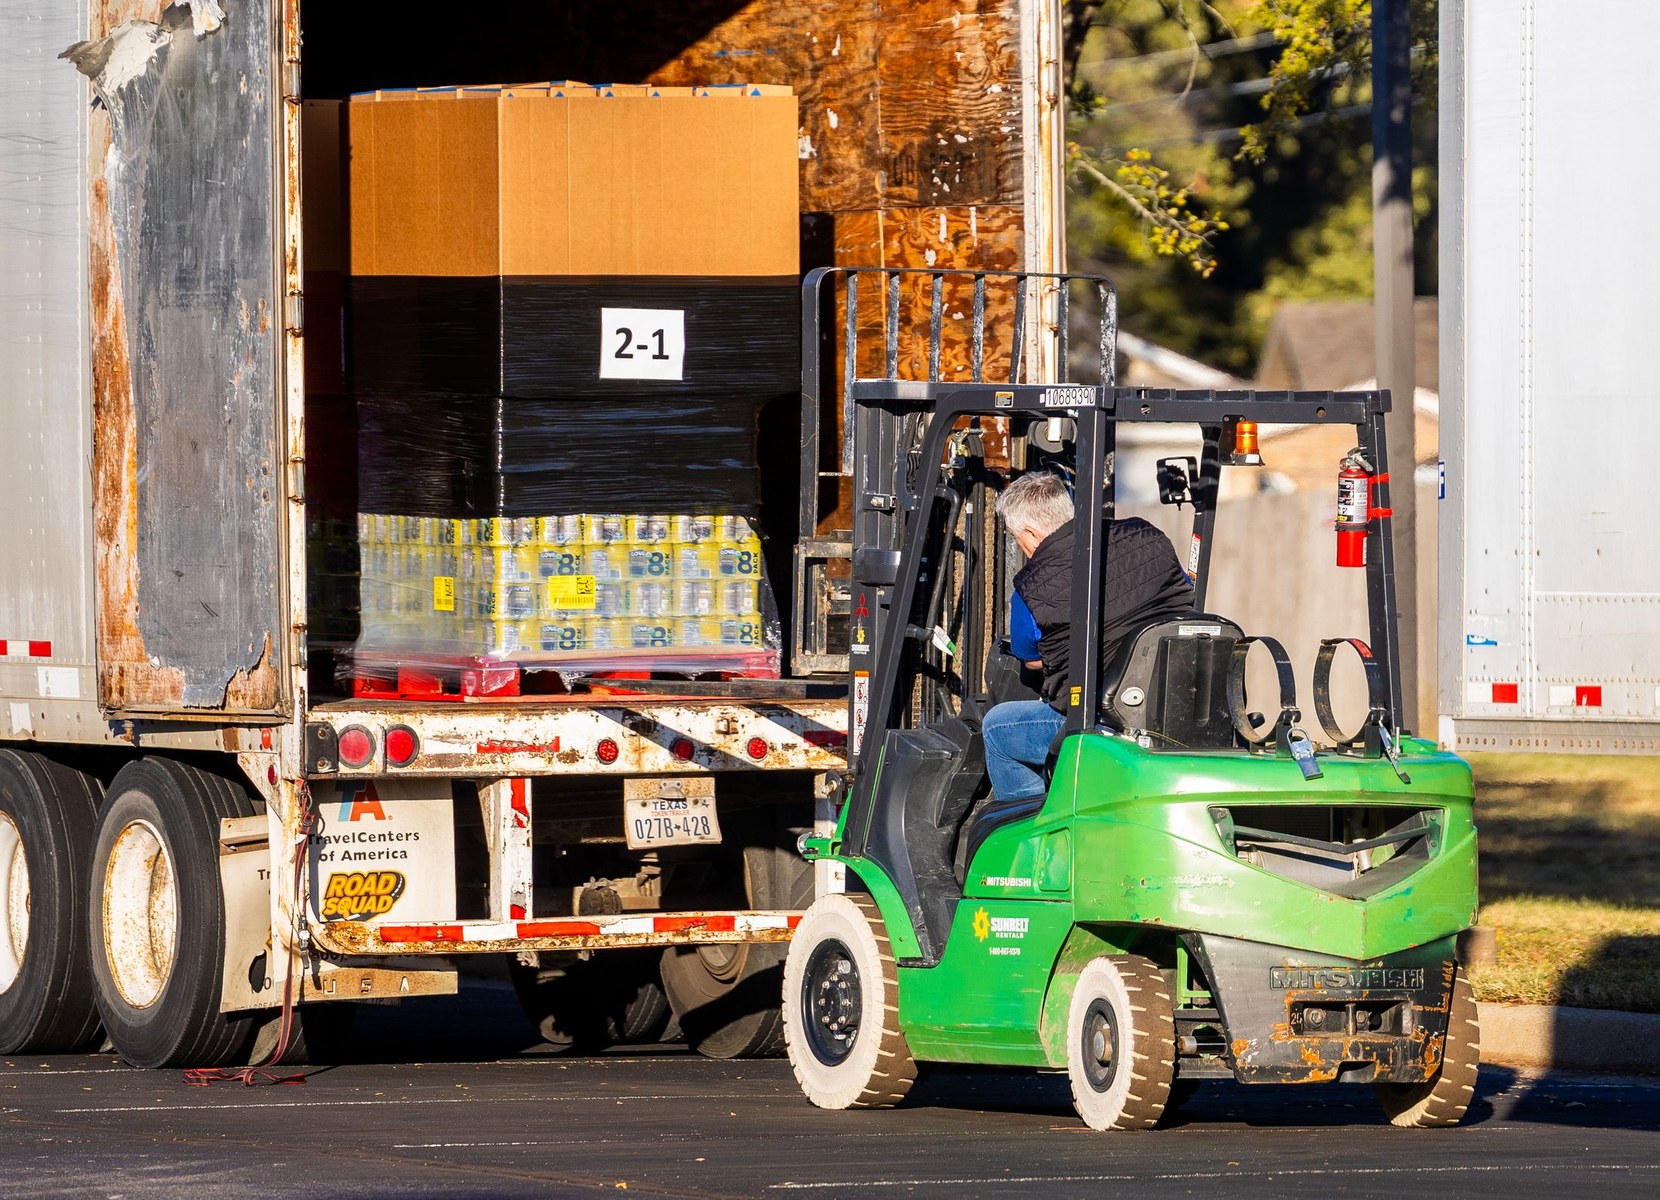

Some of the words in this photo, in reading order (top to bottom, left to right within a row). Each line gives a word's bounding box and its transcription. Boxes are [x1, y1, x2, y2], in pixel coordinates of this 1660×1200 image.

[614, 326, 670, 360] 2-1
[558, 554, 574, 575] 8
[648, 552, 664, 576] 8
[737, 551, 753, 574] 8
[559, 627, 576, 651] 8
[652, 800, 688, 811] TEXAS
[308, 830, 420, 846] TravelCenters
[318, 850, 335, 862] of
[340, 848, 408, 862] America
[326, 872, 398, 897] ROAD
[986, 876, 1032, 887] MITSUBISHI
[323, 895, 394, 918] SQUAD
[990, 917, 1030, 932] SUNBELT
